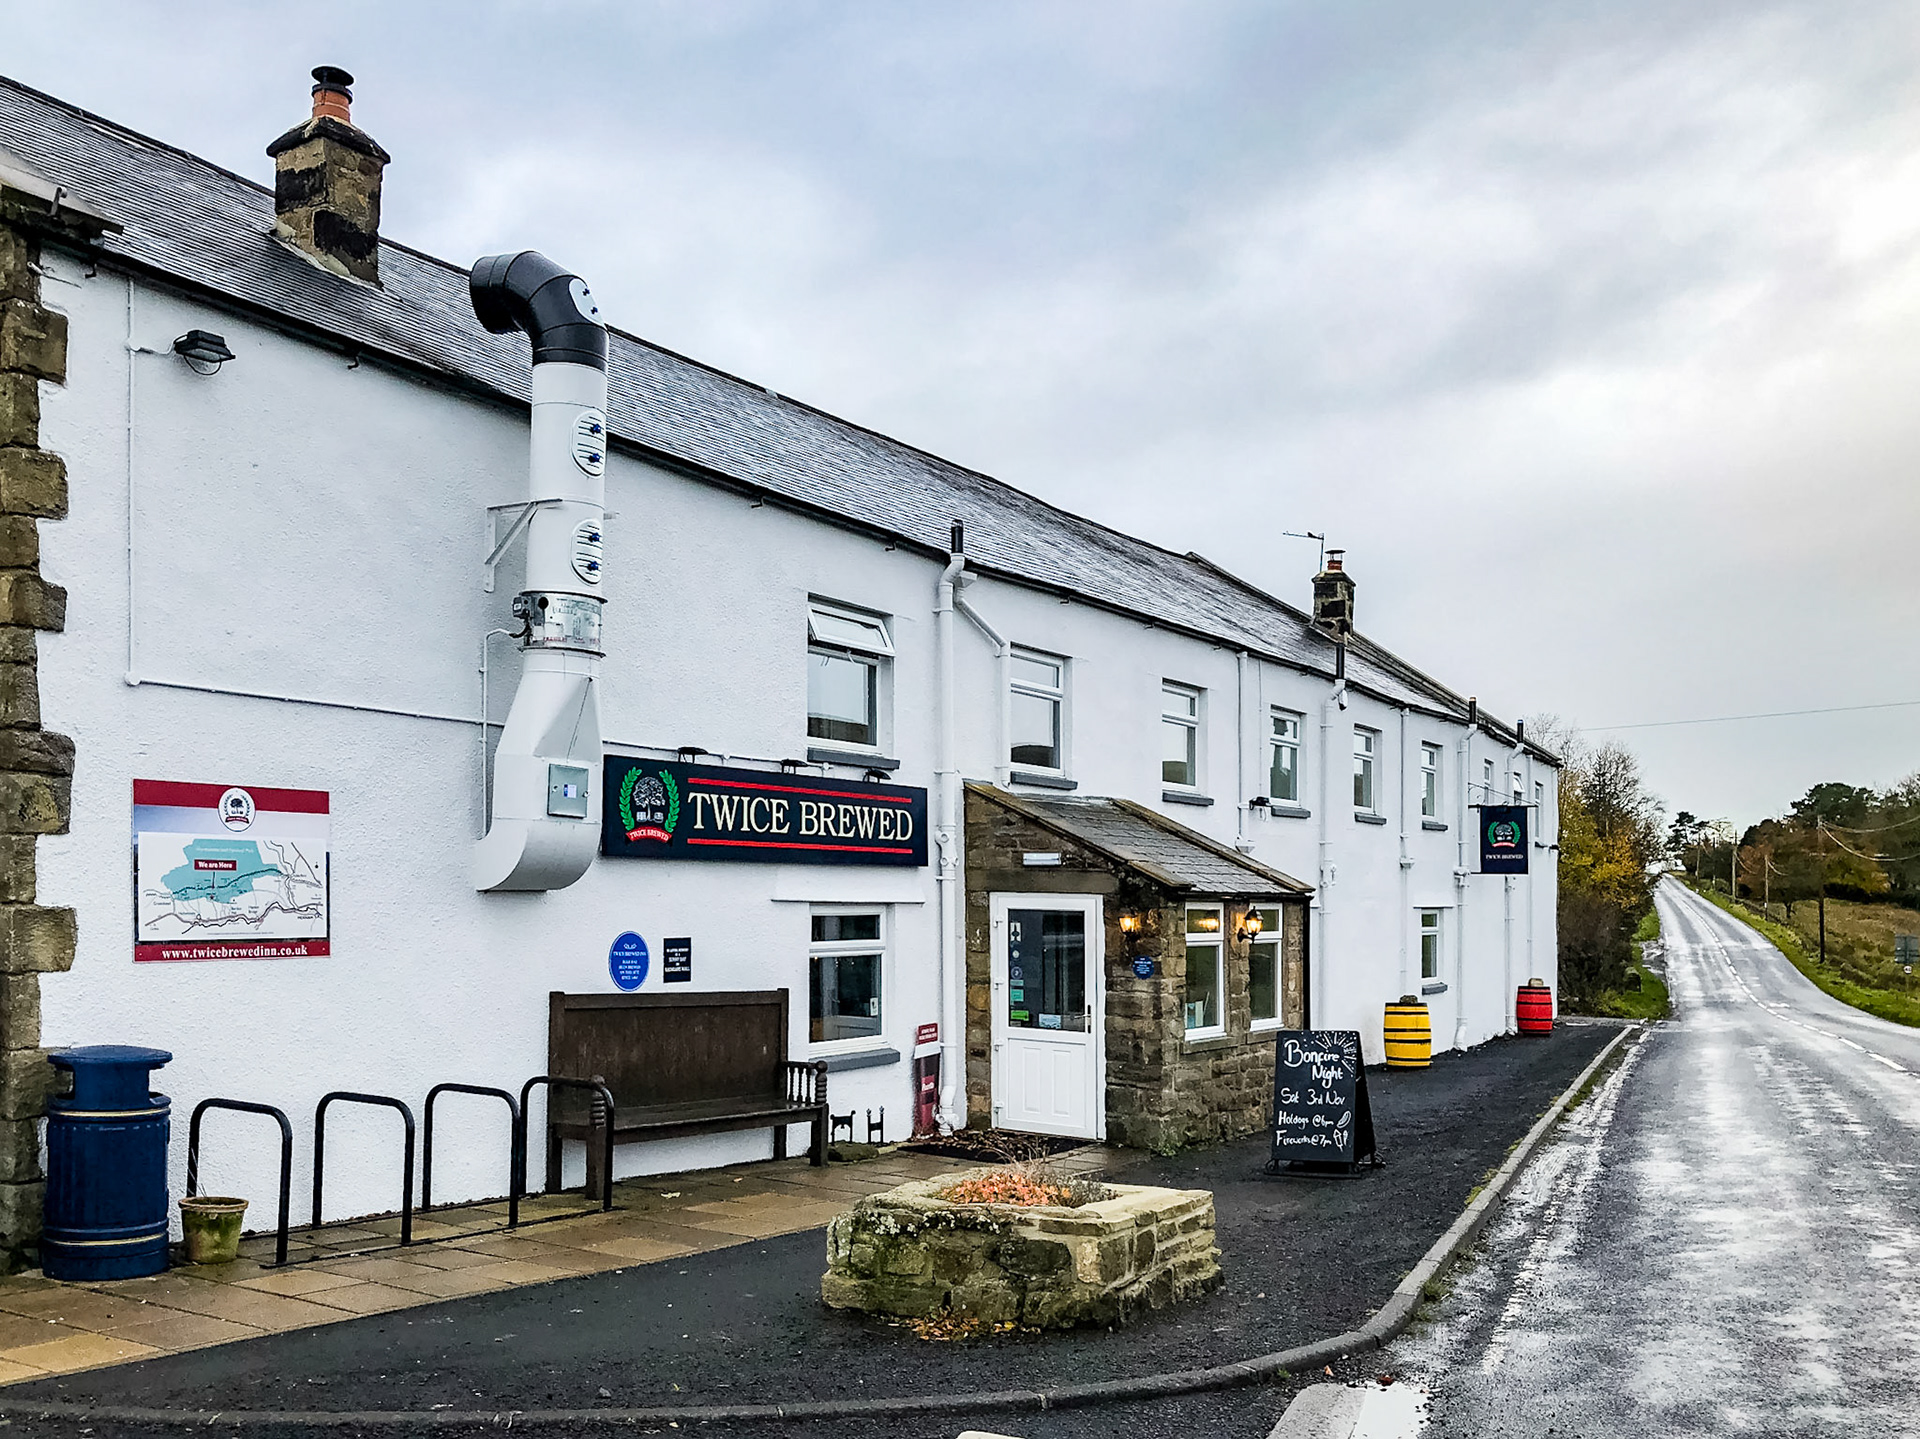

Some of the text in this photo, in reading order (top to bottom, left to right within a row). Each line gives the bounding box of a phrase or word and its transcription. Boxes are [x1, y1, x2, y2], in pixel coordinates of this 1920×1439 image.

[687, 792, 913, 841] TWICE BREWED
[629, 829, 669, 841] TWICE BREWED
[162, 944, 308, 959] www.twicebrewedinn.co.uk
[1284, 1039, 1340, 1067] Bonfire
[1312, 1064, 1344, 1088] Night
[1280, 1087, 1345, 1105] Sat 3rd Nov
